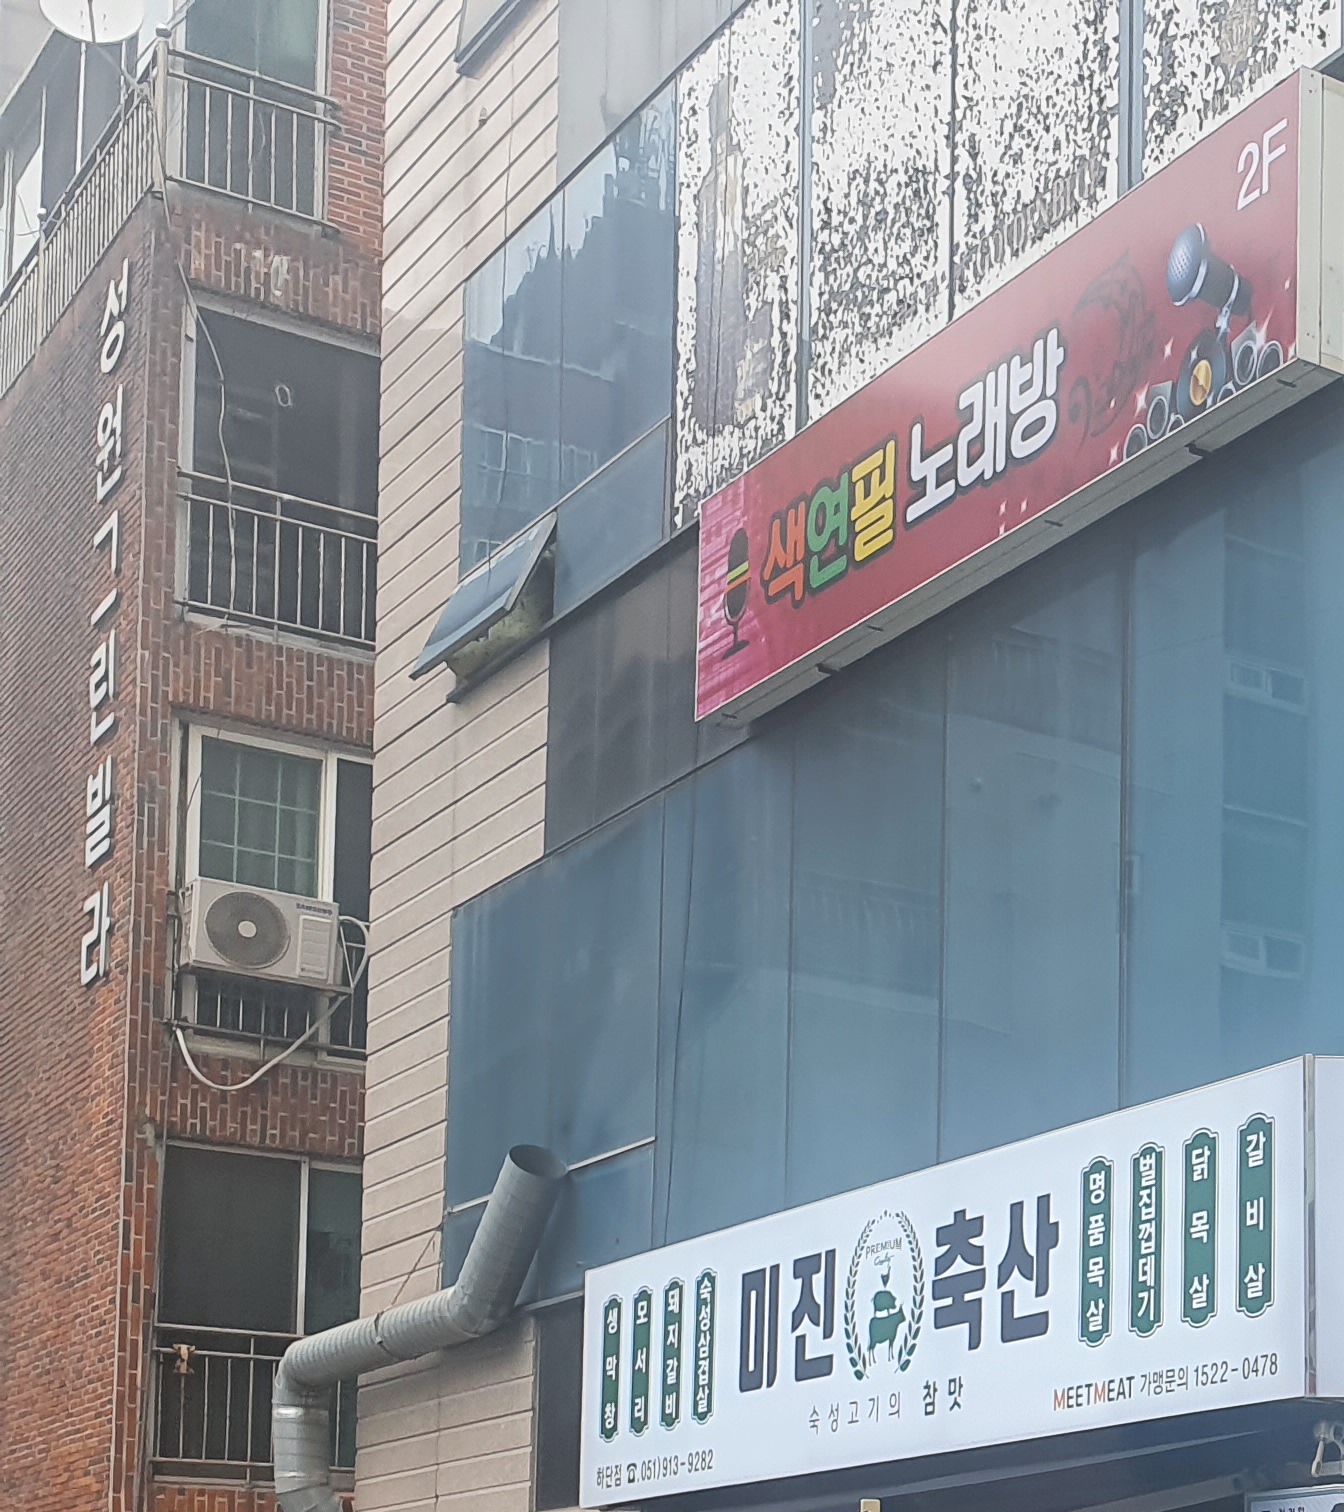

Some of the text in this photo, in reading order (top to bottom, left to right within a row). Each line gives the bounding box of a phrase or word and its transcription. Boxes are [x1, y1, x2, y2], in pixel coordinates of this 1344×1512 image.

[1236, 118, 1287, 210] 2F
[762, 328, 1066, 603] 색연필 노래방
[865, 1236, 903, 1261] PREMIUM
[1086, 1170, 1106, 1333] 명품목살
[1138, 1155, 1157, 1323] 벌집껍데기
[1189, 1145, 1211, 1312] 닭목살
[1243, 1131, 1268, 1300] 갈비살
[634, 1291, 650, 1420] 모서리
[665, 1286, 682, 1417] 돼지갈비
[695, 1278, 713, 1416] 숙성삼겹살
[739, 1193, 1060, 1393] 미진 축산
[604, 1313, 619, 1431] 생막창
[808, 1378, 966, 1434] 숙성고기의 참맛
[1053, 1354, 1280, 1413] MEETMEAT 가맹문의 1522-0478
[595, 1461, 623, 1491] 하단점
